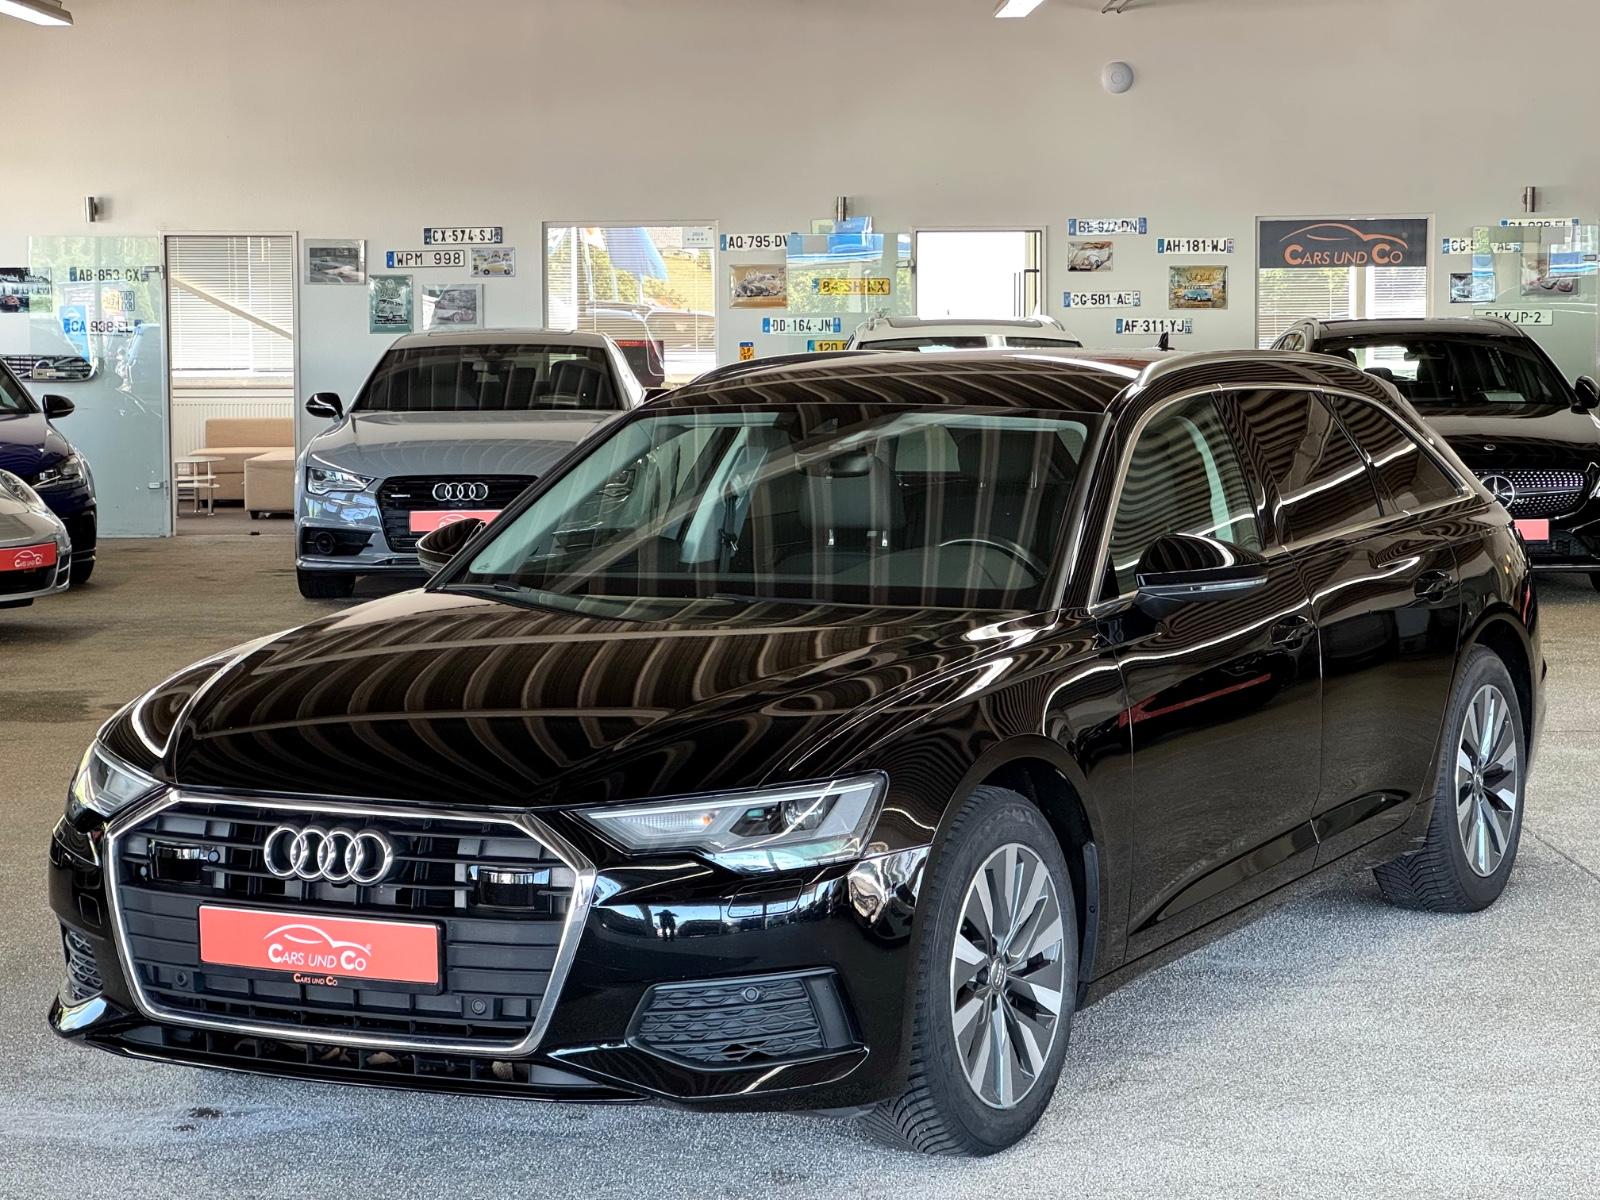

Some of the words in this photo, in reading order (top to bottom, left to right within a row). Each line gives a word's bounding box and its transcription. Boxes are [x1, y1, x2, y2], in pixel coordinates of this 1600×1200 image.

[432, 229, 494, 242] CX-574-SJ
[1165, 239, 1227, 253] AH-181-WJ
[396, 253, 424, 266] WPM
[433, 252, 462, 265] 998
[71, 320, 134, 334] CA938-EL
[771, 319, 832, 333] DD-164-JN
[1123, 319, 1185, 333] AF-311-YJ
